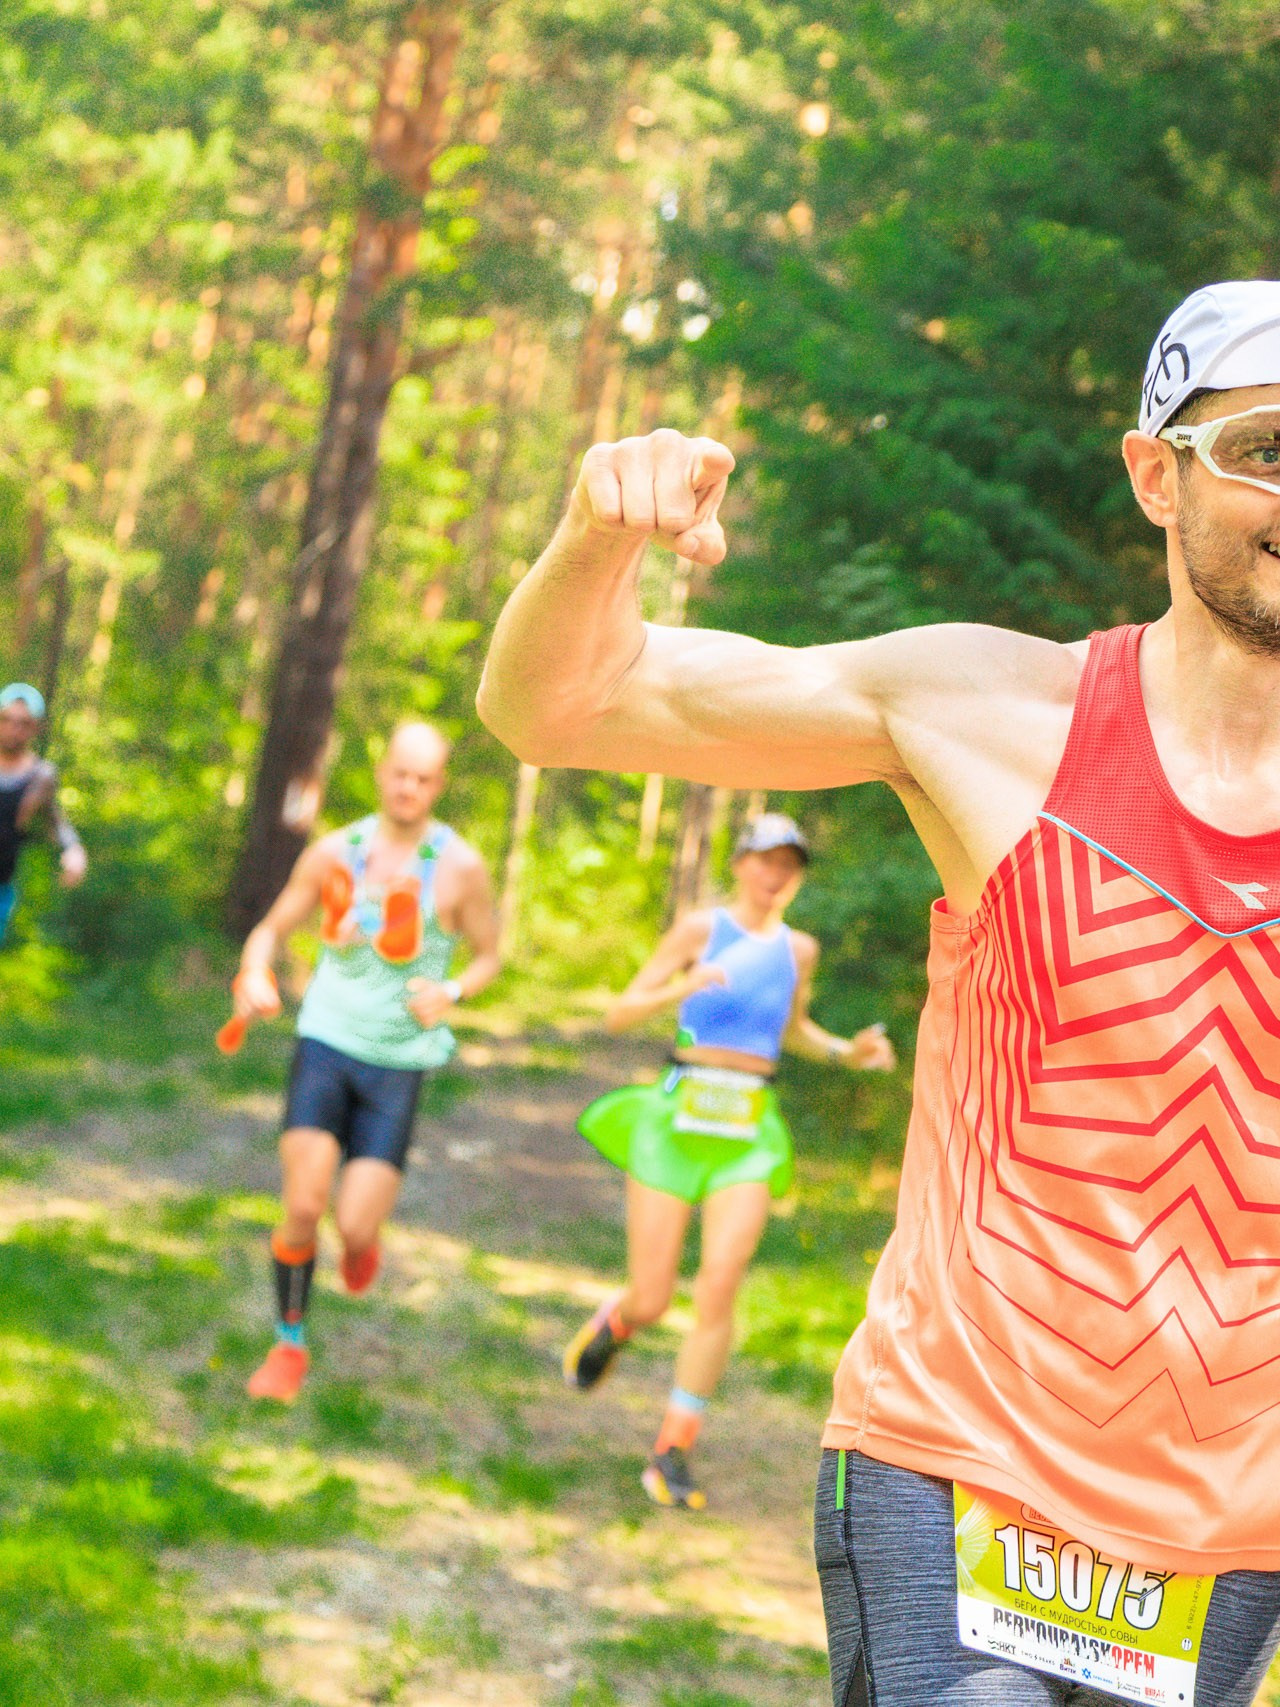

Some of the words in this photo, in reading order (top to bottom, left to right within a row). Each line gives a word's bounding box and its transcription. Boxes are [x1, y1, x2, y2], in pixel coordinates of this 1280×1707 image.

[994, 1522, 1167, 1631] 15075
[1014, 1597, 1037, 1614] БЕГИ
[1040, 1606, 1046, 1617] С
[1049, 1609, 1108, 1637] МУДРОСТЬЮ
[1110, 1629, 1139, 1645] СОВЫ
